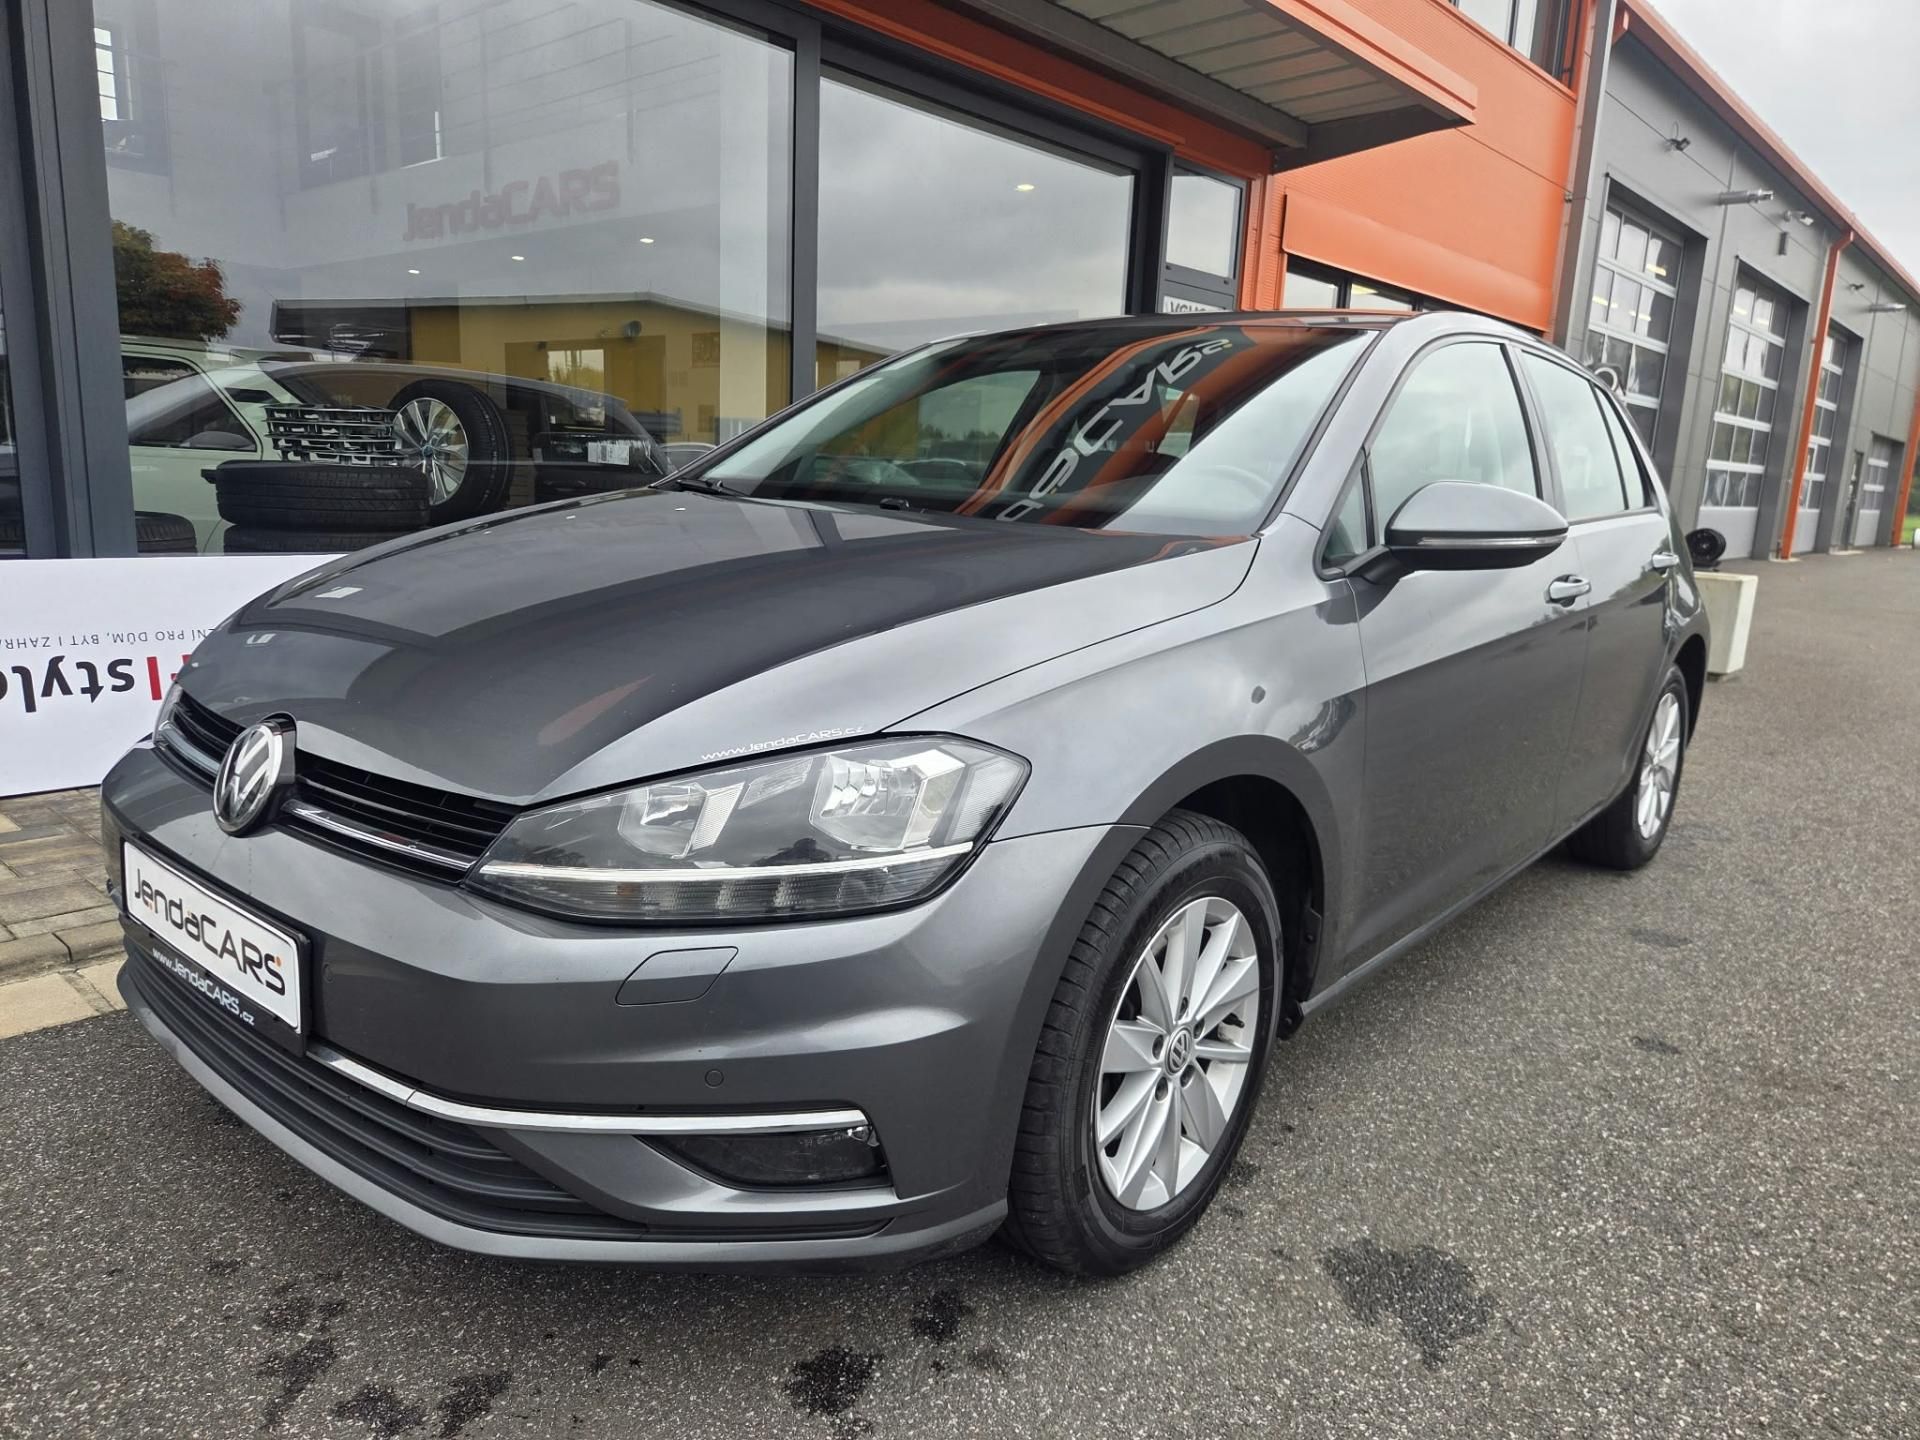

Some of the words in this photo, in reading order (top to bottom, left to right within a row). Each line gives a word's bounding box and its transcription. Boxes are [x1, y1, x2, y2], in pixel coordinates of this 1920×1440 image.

[403, 160, 621, 242] JendaCARS
[0, 636, 50, 650] ZAHR
[72, 634, 99, 645] BYT
[106, 631, 148, 645] DŮM,
[155, 631, 185, 641] PRO
[701, 726, 865, 761] www.JendaCARS.cz
[134, 867, 286, 996] JendaCARS
[152, 947, 255, 1026] www.JendaCARS.cz
